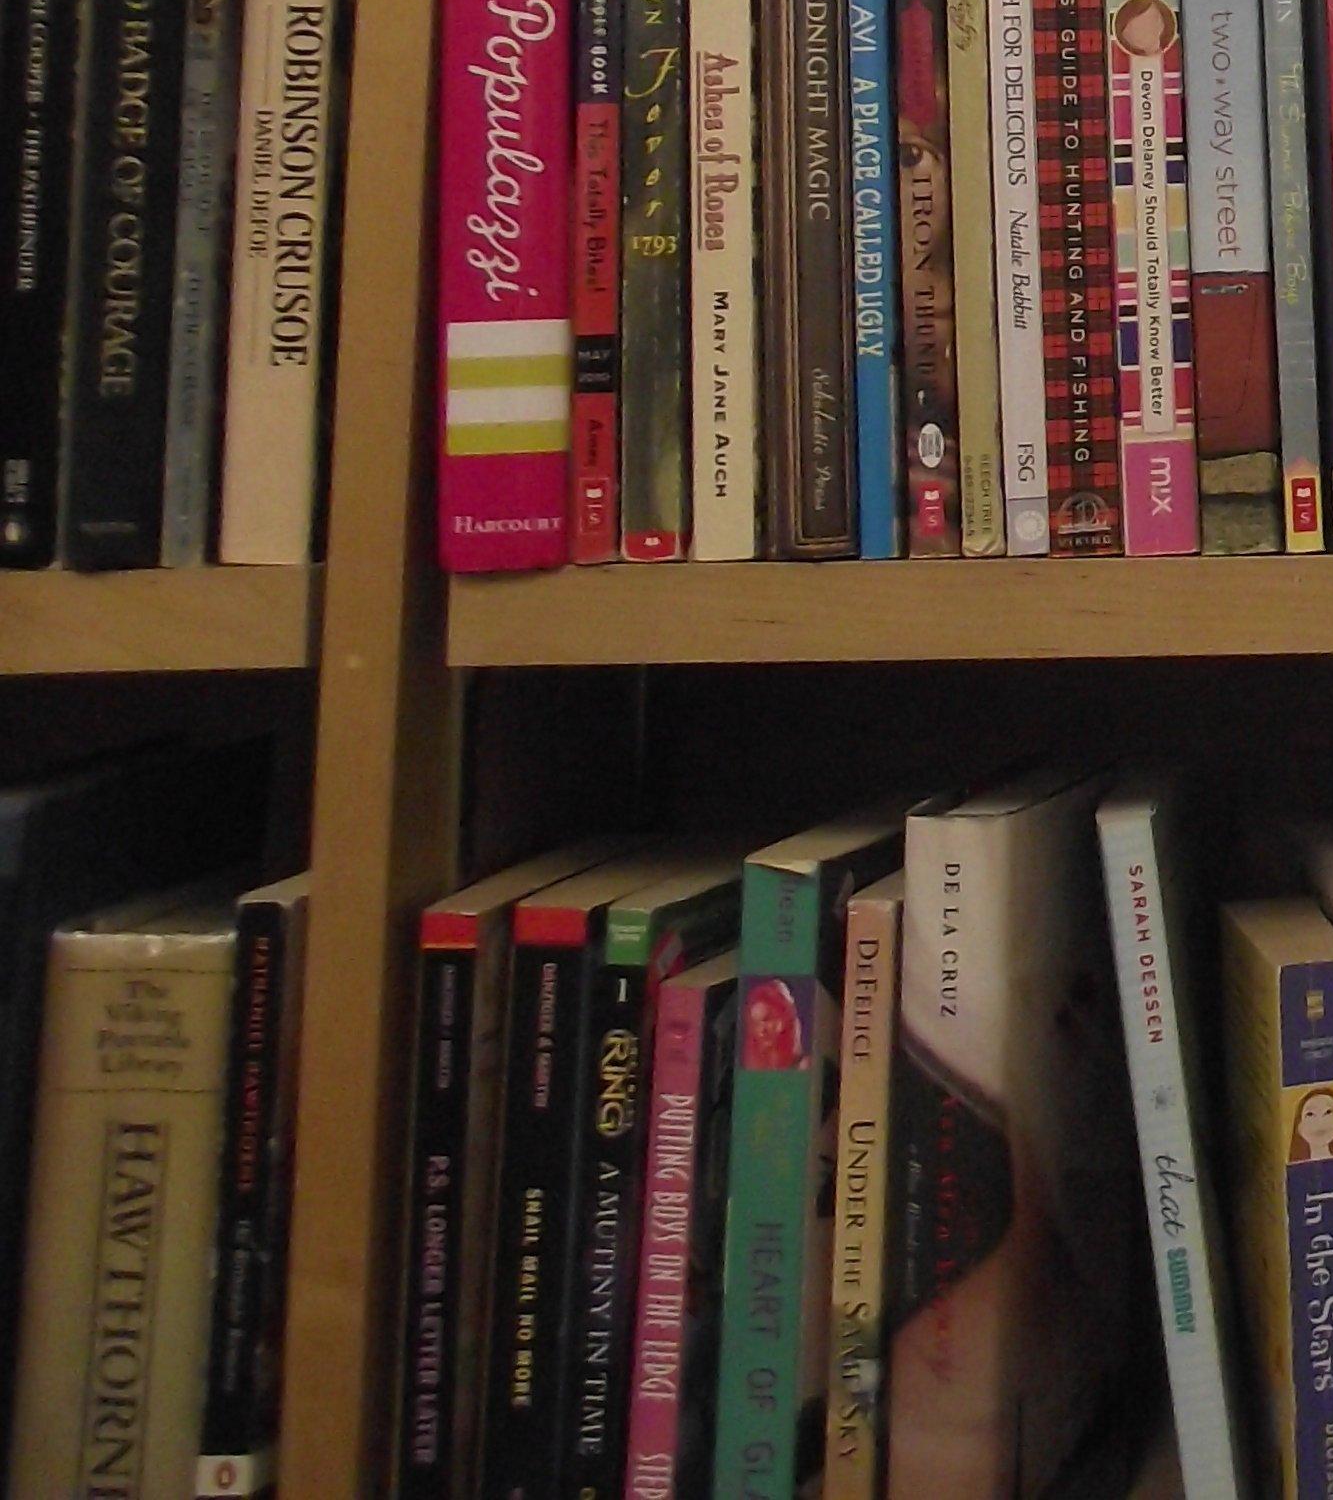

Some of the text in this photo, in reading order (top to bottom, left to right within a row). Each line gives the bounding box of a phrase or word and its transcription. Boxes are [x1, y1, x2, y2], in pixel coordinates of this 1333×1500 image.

[112, 19, 151, 147] BADGE
[1061, 28, 1078, 106] GUIDE
[1140, 70, 1154, 121] Devon
[1063, 118, 1079, 150] TO
[1140, 126, 1156, 189] Delaney
[249, 110, 273, 258] DANIEL DEFOE
[270, 4, 325, 367] ROBINSON CRUSOE
[851, 5, 884, 357] AVI A PLACE CALLED UGLY
[632, 235, 678, 256] 1793
[1066, 164, 1084, 280] HUNTING
[1143, 196, 1160, 251] Should
[99, 213, 144, 397] COURAGE
[699, 52, 740, 497] Ashes of Roses MARY JANE AUCH
[1144, 257, 1162, 310] Totally
[1070, 292, 1086, 342] AND
[1148, 315, 1163, 361] Know
[1072, 356, 1090, 464] FISHING
[1149, 366, 1165, 416] Better
[1149, 457, 1174, 516] mix
[453, 516, 559, 533] HARCOURT
[940, 862, 961, 1018] DE LA CRUZ
